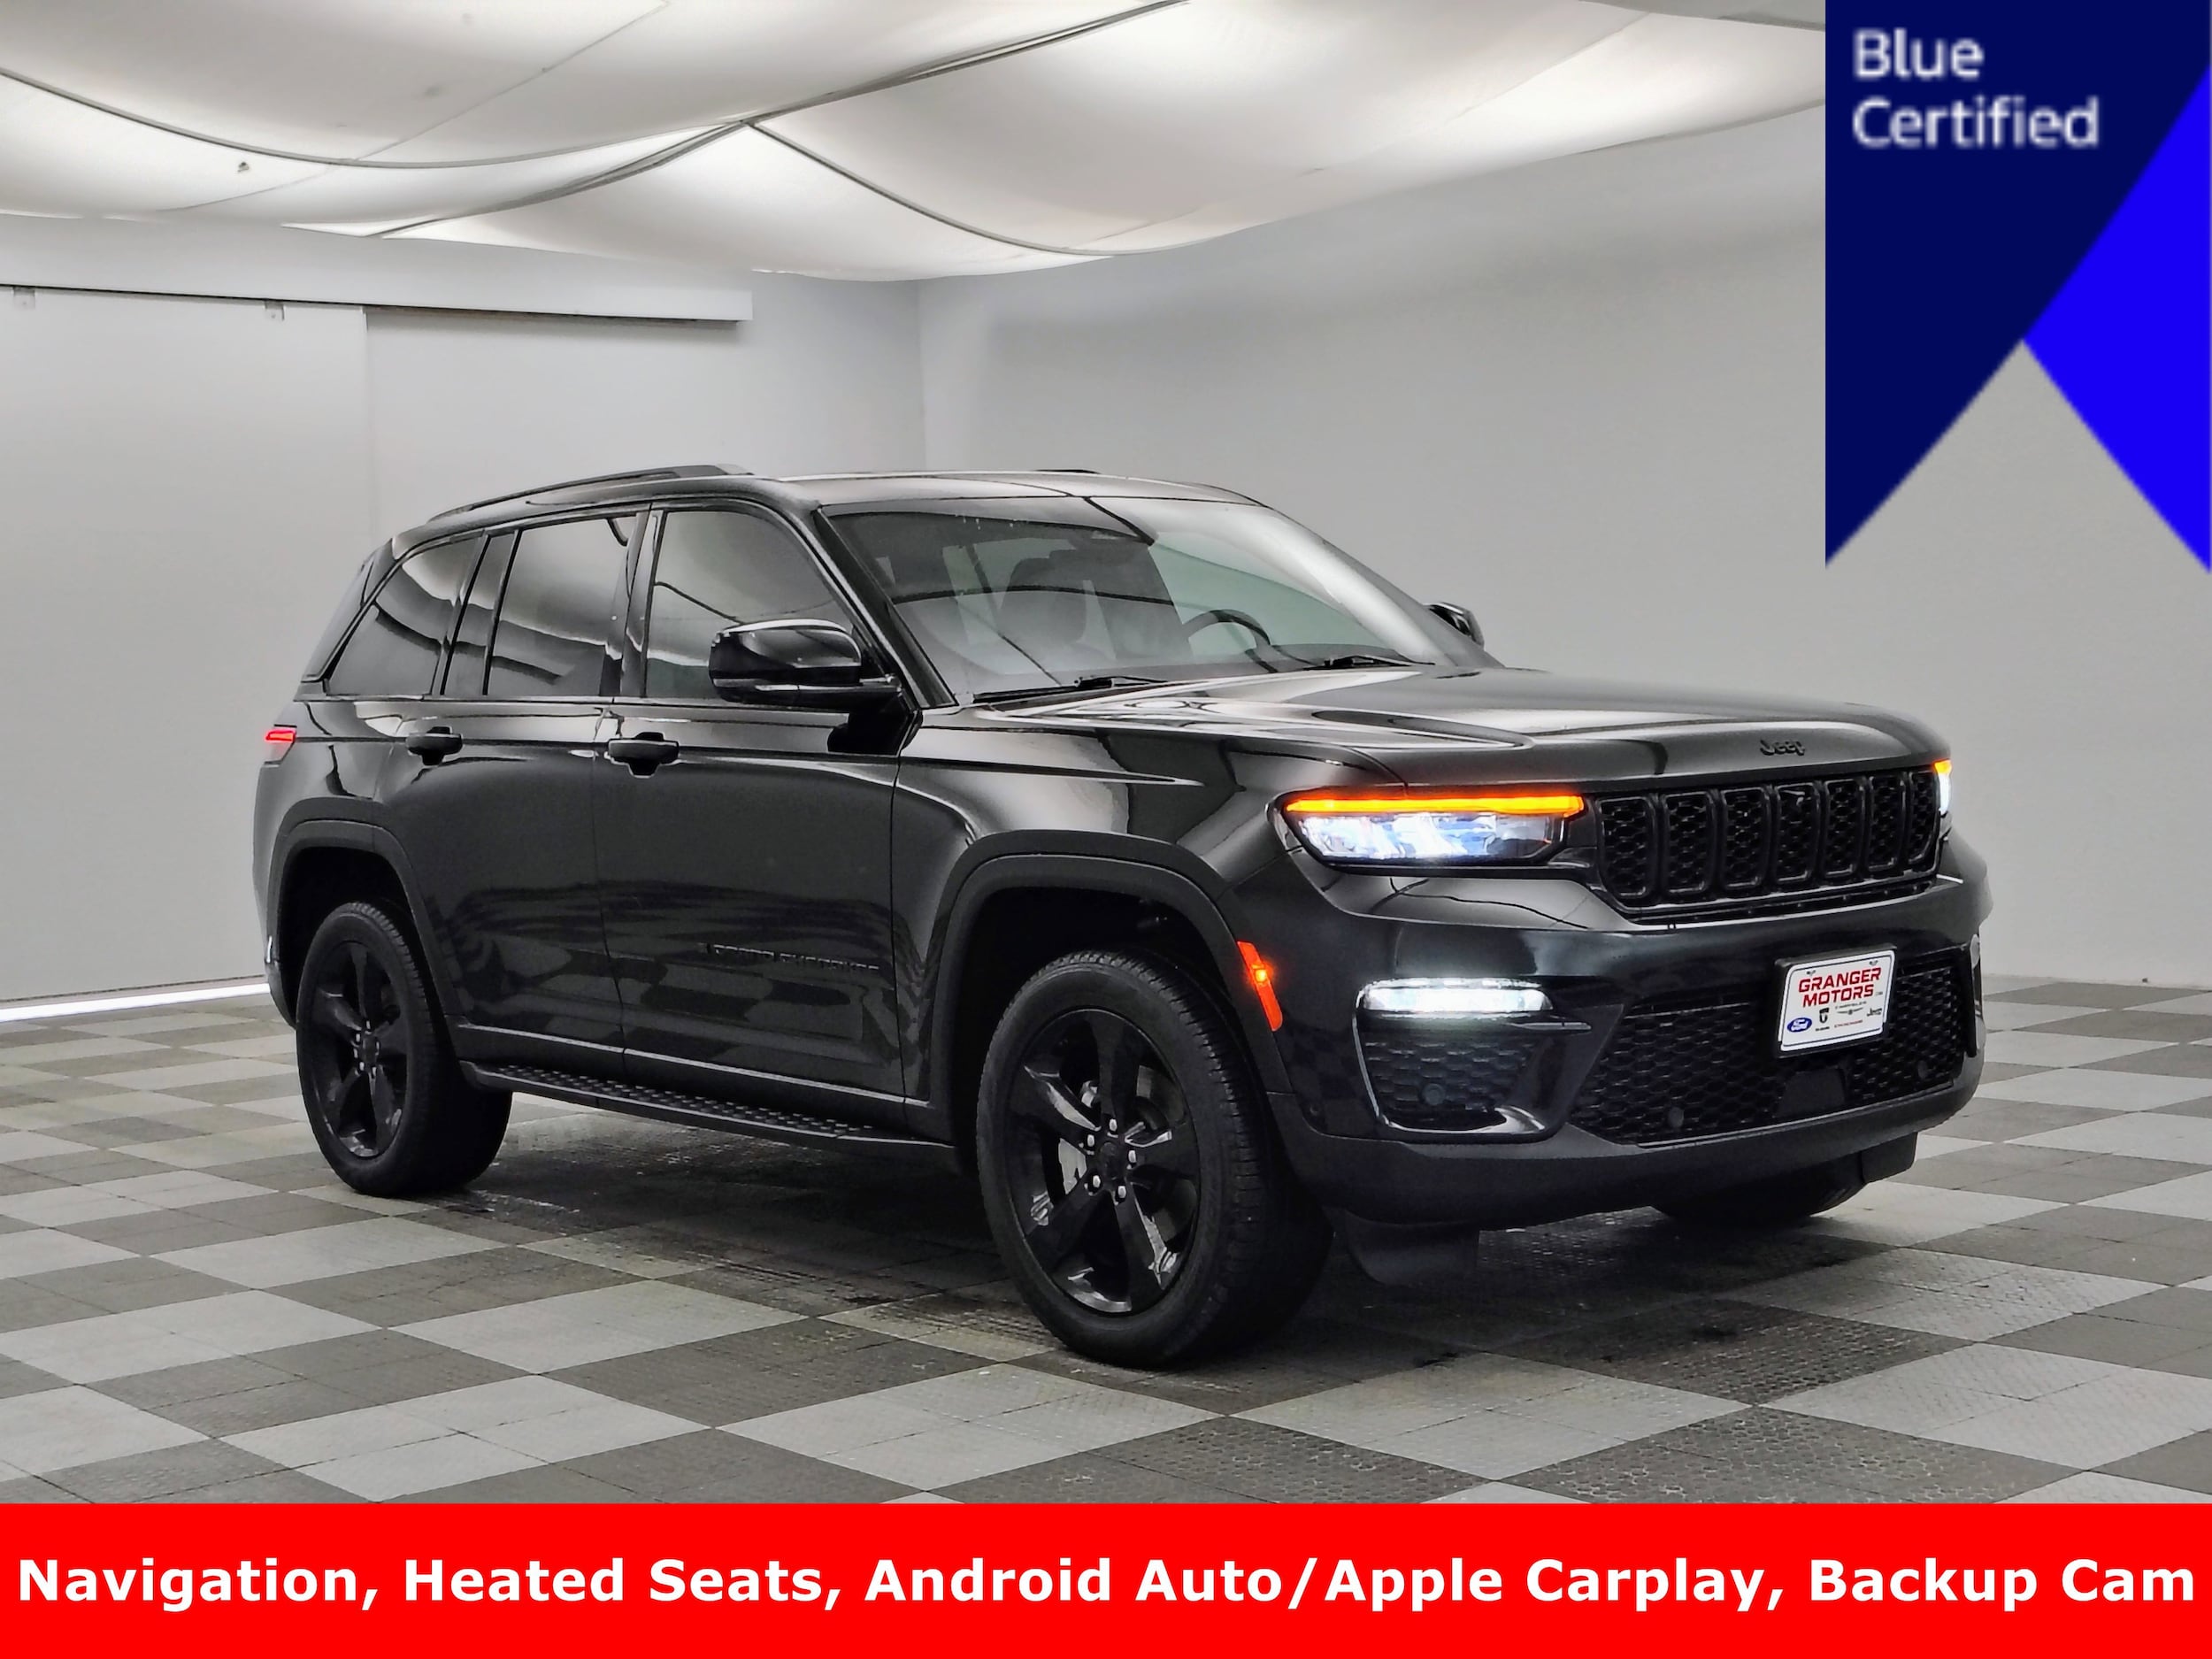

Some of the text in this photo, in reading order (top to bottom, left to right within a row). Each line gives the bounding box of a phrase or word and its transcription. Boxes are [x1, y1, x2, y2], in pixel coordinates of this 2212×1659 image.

[1760, 740, 1806, 757] Jeep
[1798, 967, 1882, 993] GRANGER
[1802, 984, 1875, 1007] MOTORS
